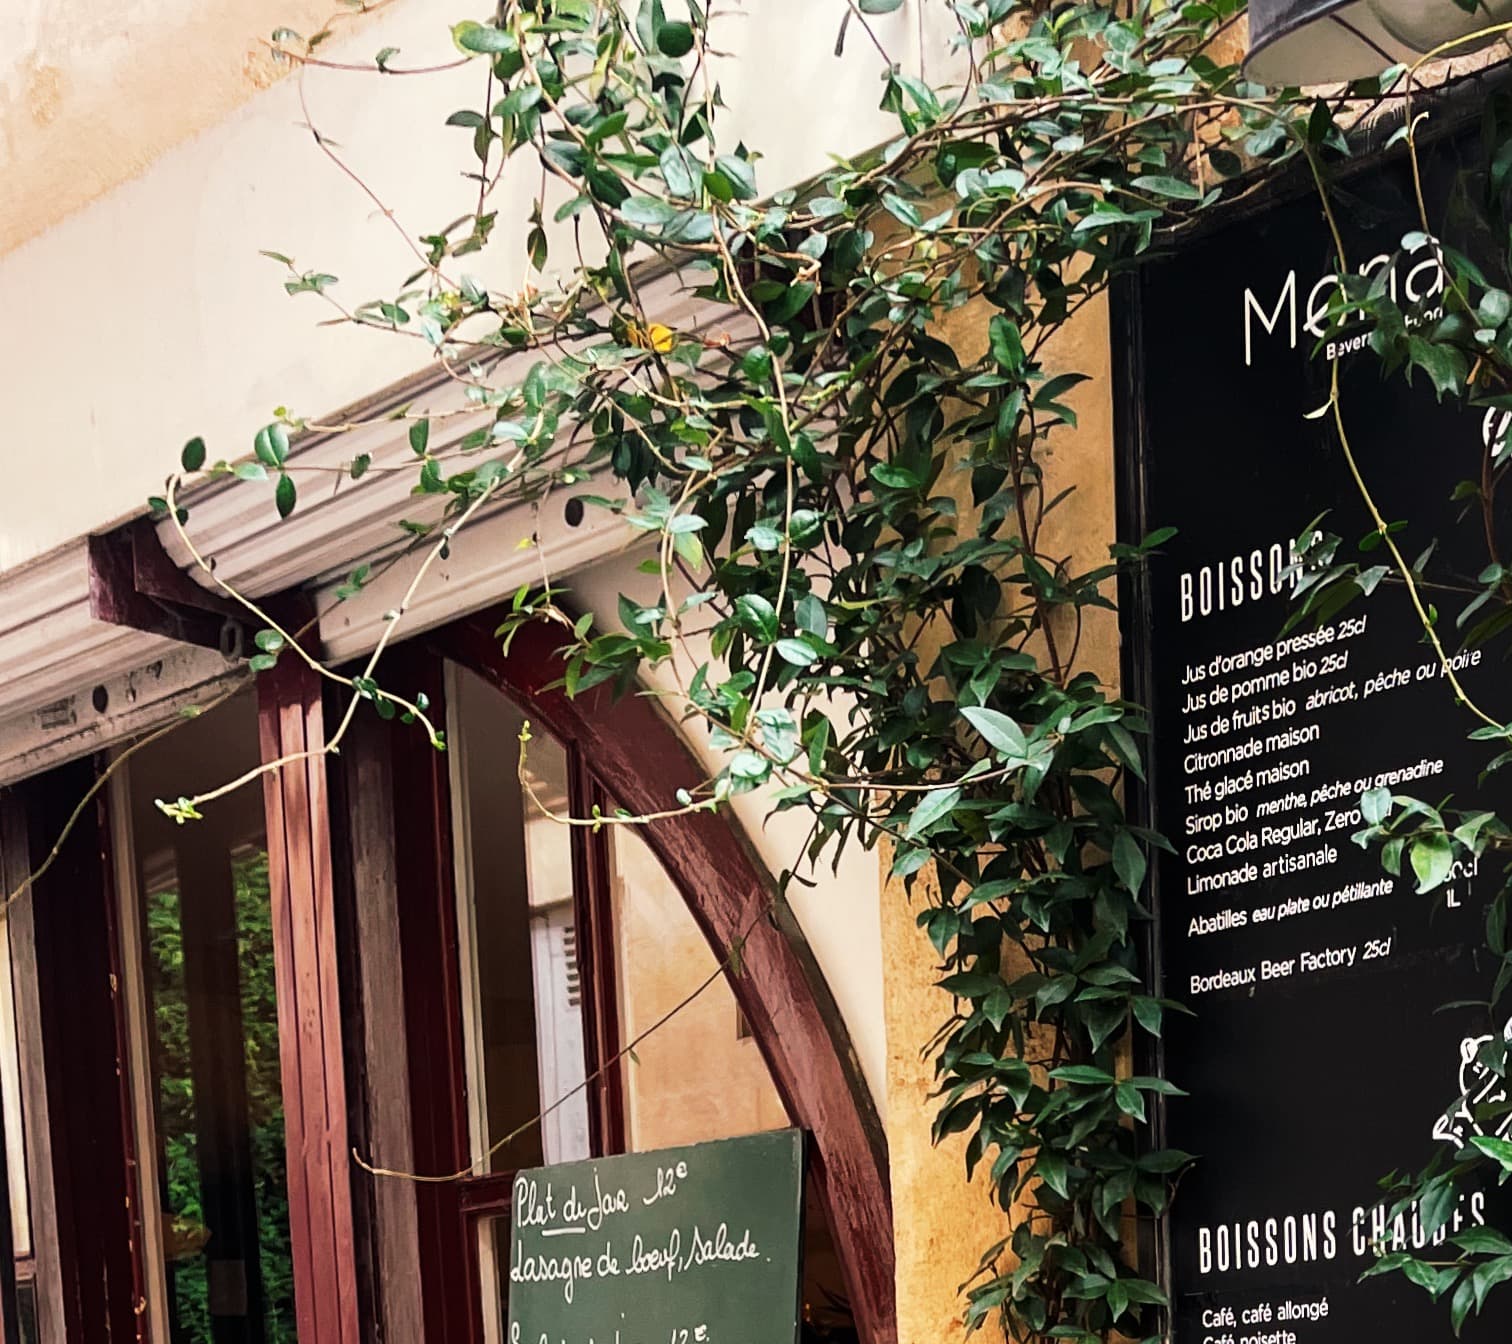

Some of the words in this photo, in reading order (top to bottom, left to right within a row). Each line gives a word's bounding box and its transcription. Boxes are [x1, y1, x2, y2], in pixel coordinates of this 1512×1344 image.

[1180, 663, 1206, 685] Jus
[1207, 643, 1274, 677] d'orange
[1275, 623, 1335, 661] pressée
[1335, 613, 1367, 640] 25cl
[1183, 736, 1263, 774] Citronnade
[1264, 723, 1320, 753] maison
[1183, 779, 1212, 804] Thé
[1213, 768, 1254, 801] glacé
[1255, 758, 1310, 788] maison
[1184, 811, 1223, 835] Sirop
[1224, 802, 1249, 825] bio
[1185, 841, 1223, 865] Coca
[1224, 829, 1258, 855] Cola
[1260, 816, 1322, 847] Regular,
[1323, 808, 1361, 832] Zero
[1186, 861, 1258, 895] Limonade
[1261, 842, 1338, 878] artisanale
[1187, 908, 1248, 937] Abatilles
[1189, 966, 1256, 994] Bordeaux
[1260, 958, 1294, 980] Beer
[1299, 945, 1357, 972] Factory
[1361, 935, 1392, 960] 25cl
[517, 1177, 555, 1226] Plat
[1198, 1209, 1336, 1274] BOISSONS
[1201, 1305, 1237, 1328] Café,
[1240, 1301, 1273, 1324] café
[1276, 1296, 1329, 1321] allongé
